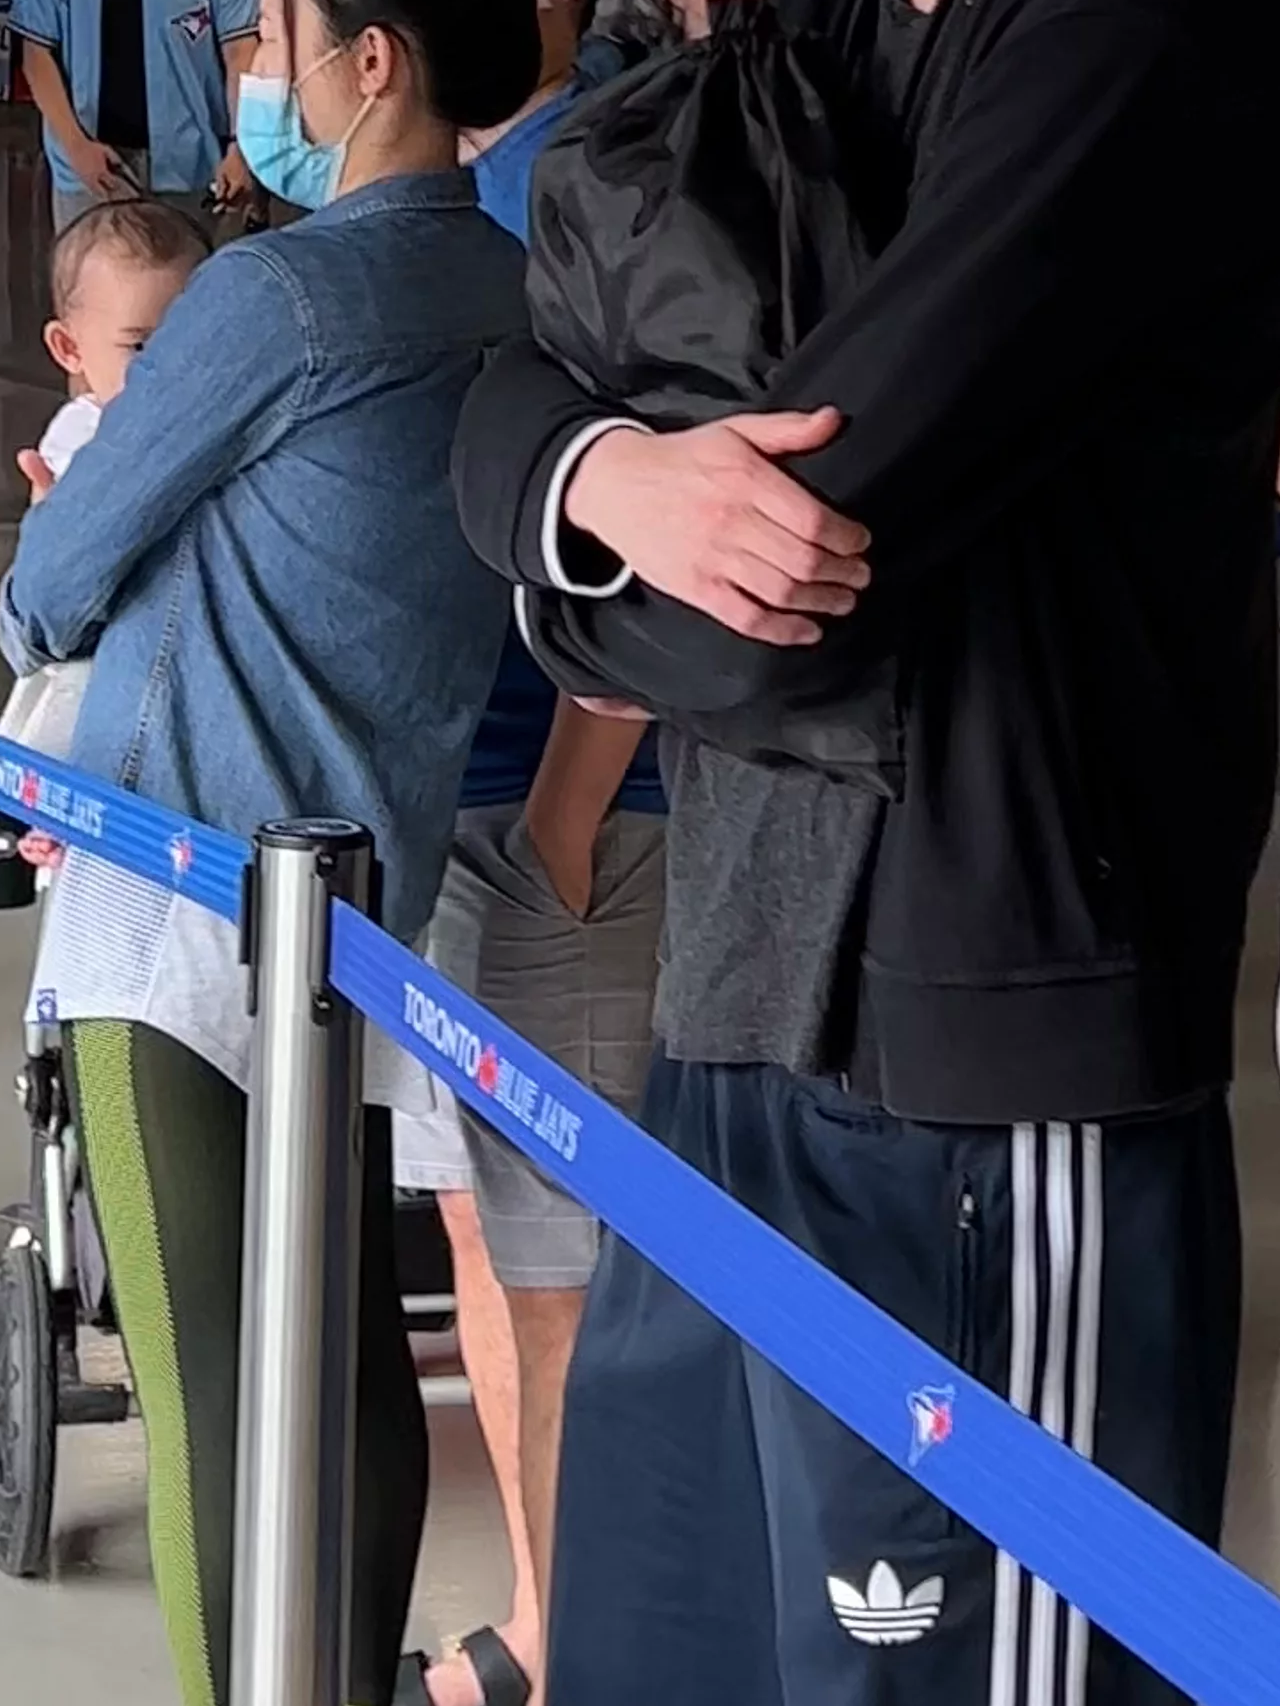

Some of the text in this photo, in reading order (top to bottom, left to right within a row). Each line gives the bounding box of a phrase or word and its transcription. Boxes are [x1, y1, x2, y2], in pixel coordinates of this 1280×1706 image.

[403, 981, 584, 1163] TORONTO BLUE JAYS
